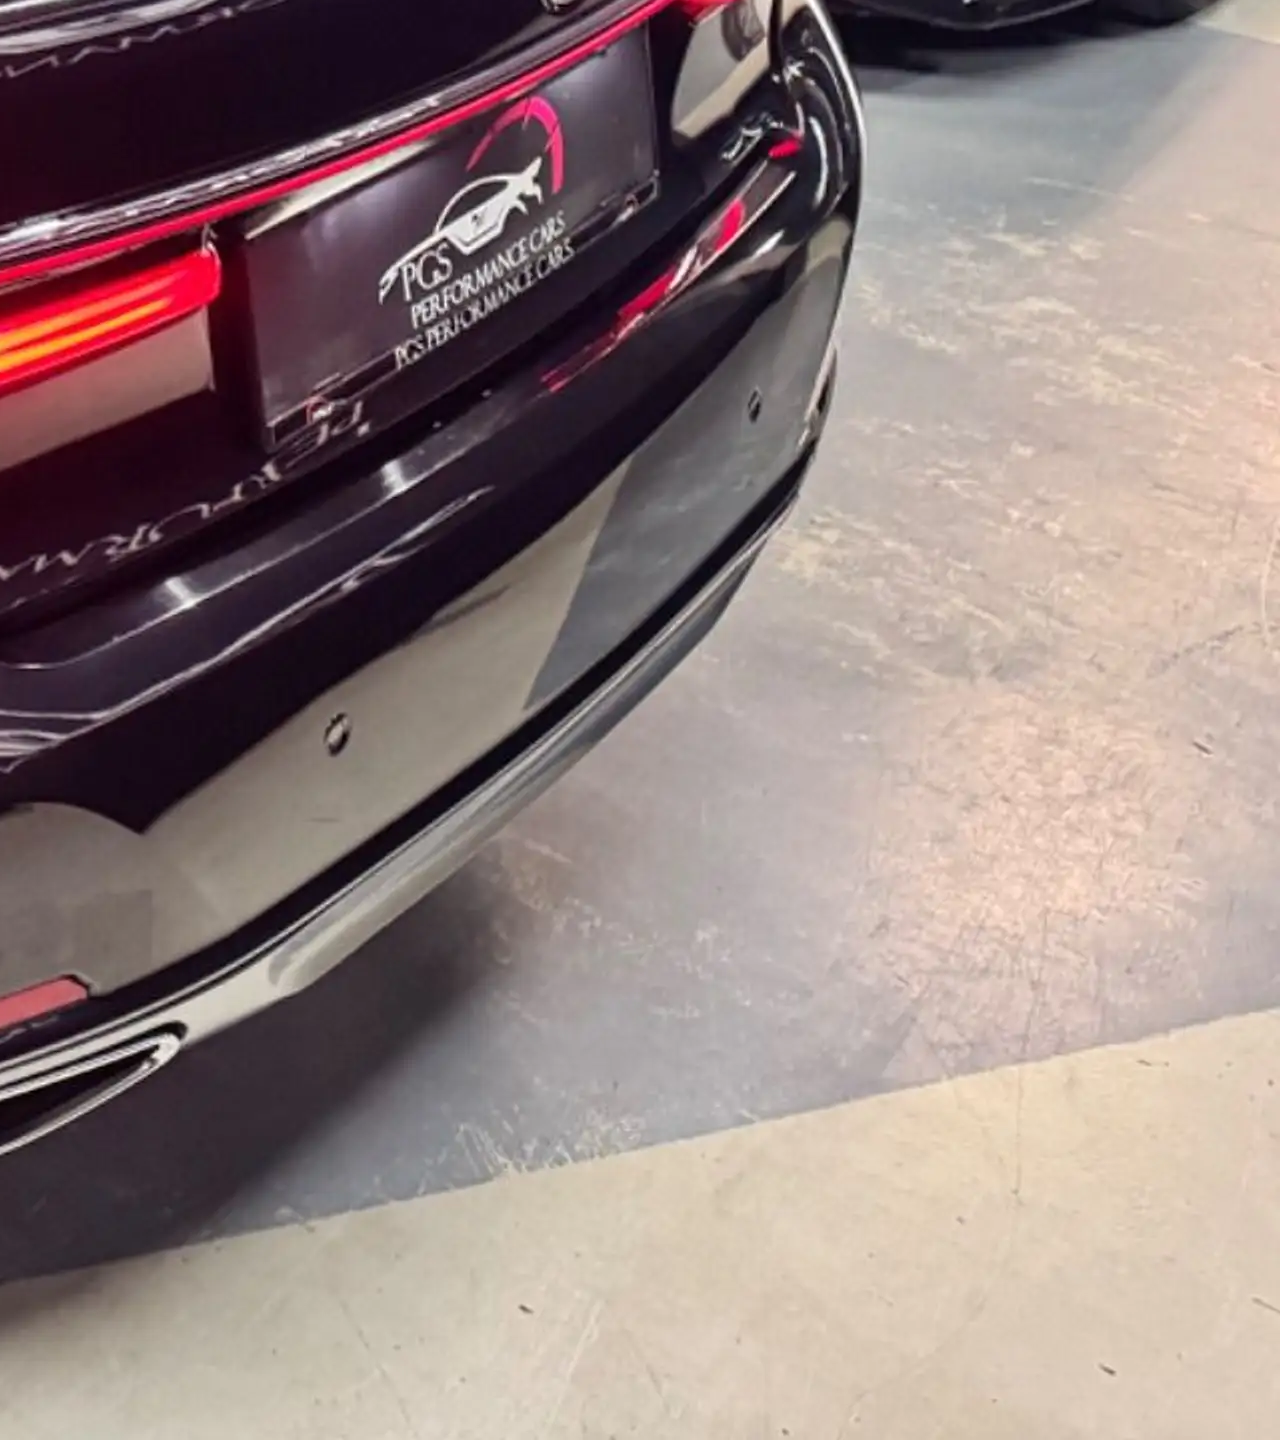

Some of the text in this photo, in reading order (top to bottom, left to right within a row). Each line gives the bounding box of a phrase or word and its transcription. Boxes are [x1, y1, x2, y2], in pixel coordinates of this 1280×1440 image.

[400, 242, 454, 302] PGS
[411, 211, 566, 330] PERFORMANCE CARS
[424, 266, 534, 351] PERFORMANCE
[536, 239, 576, 279] CARS
